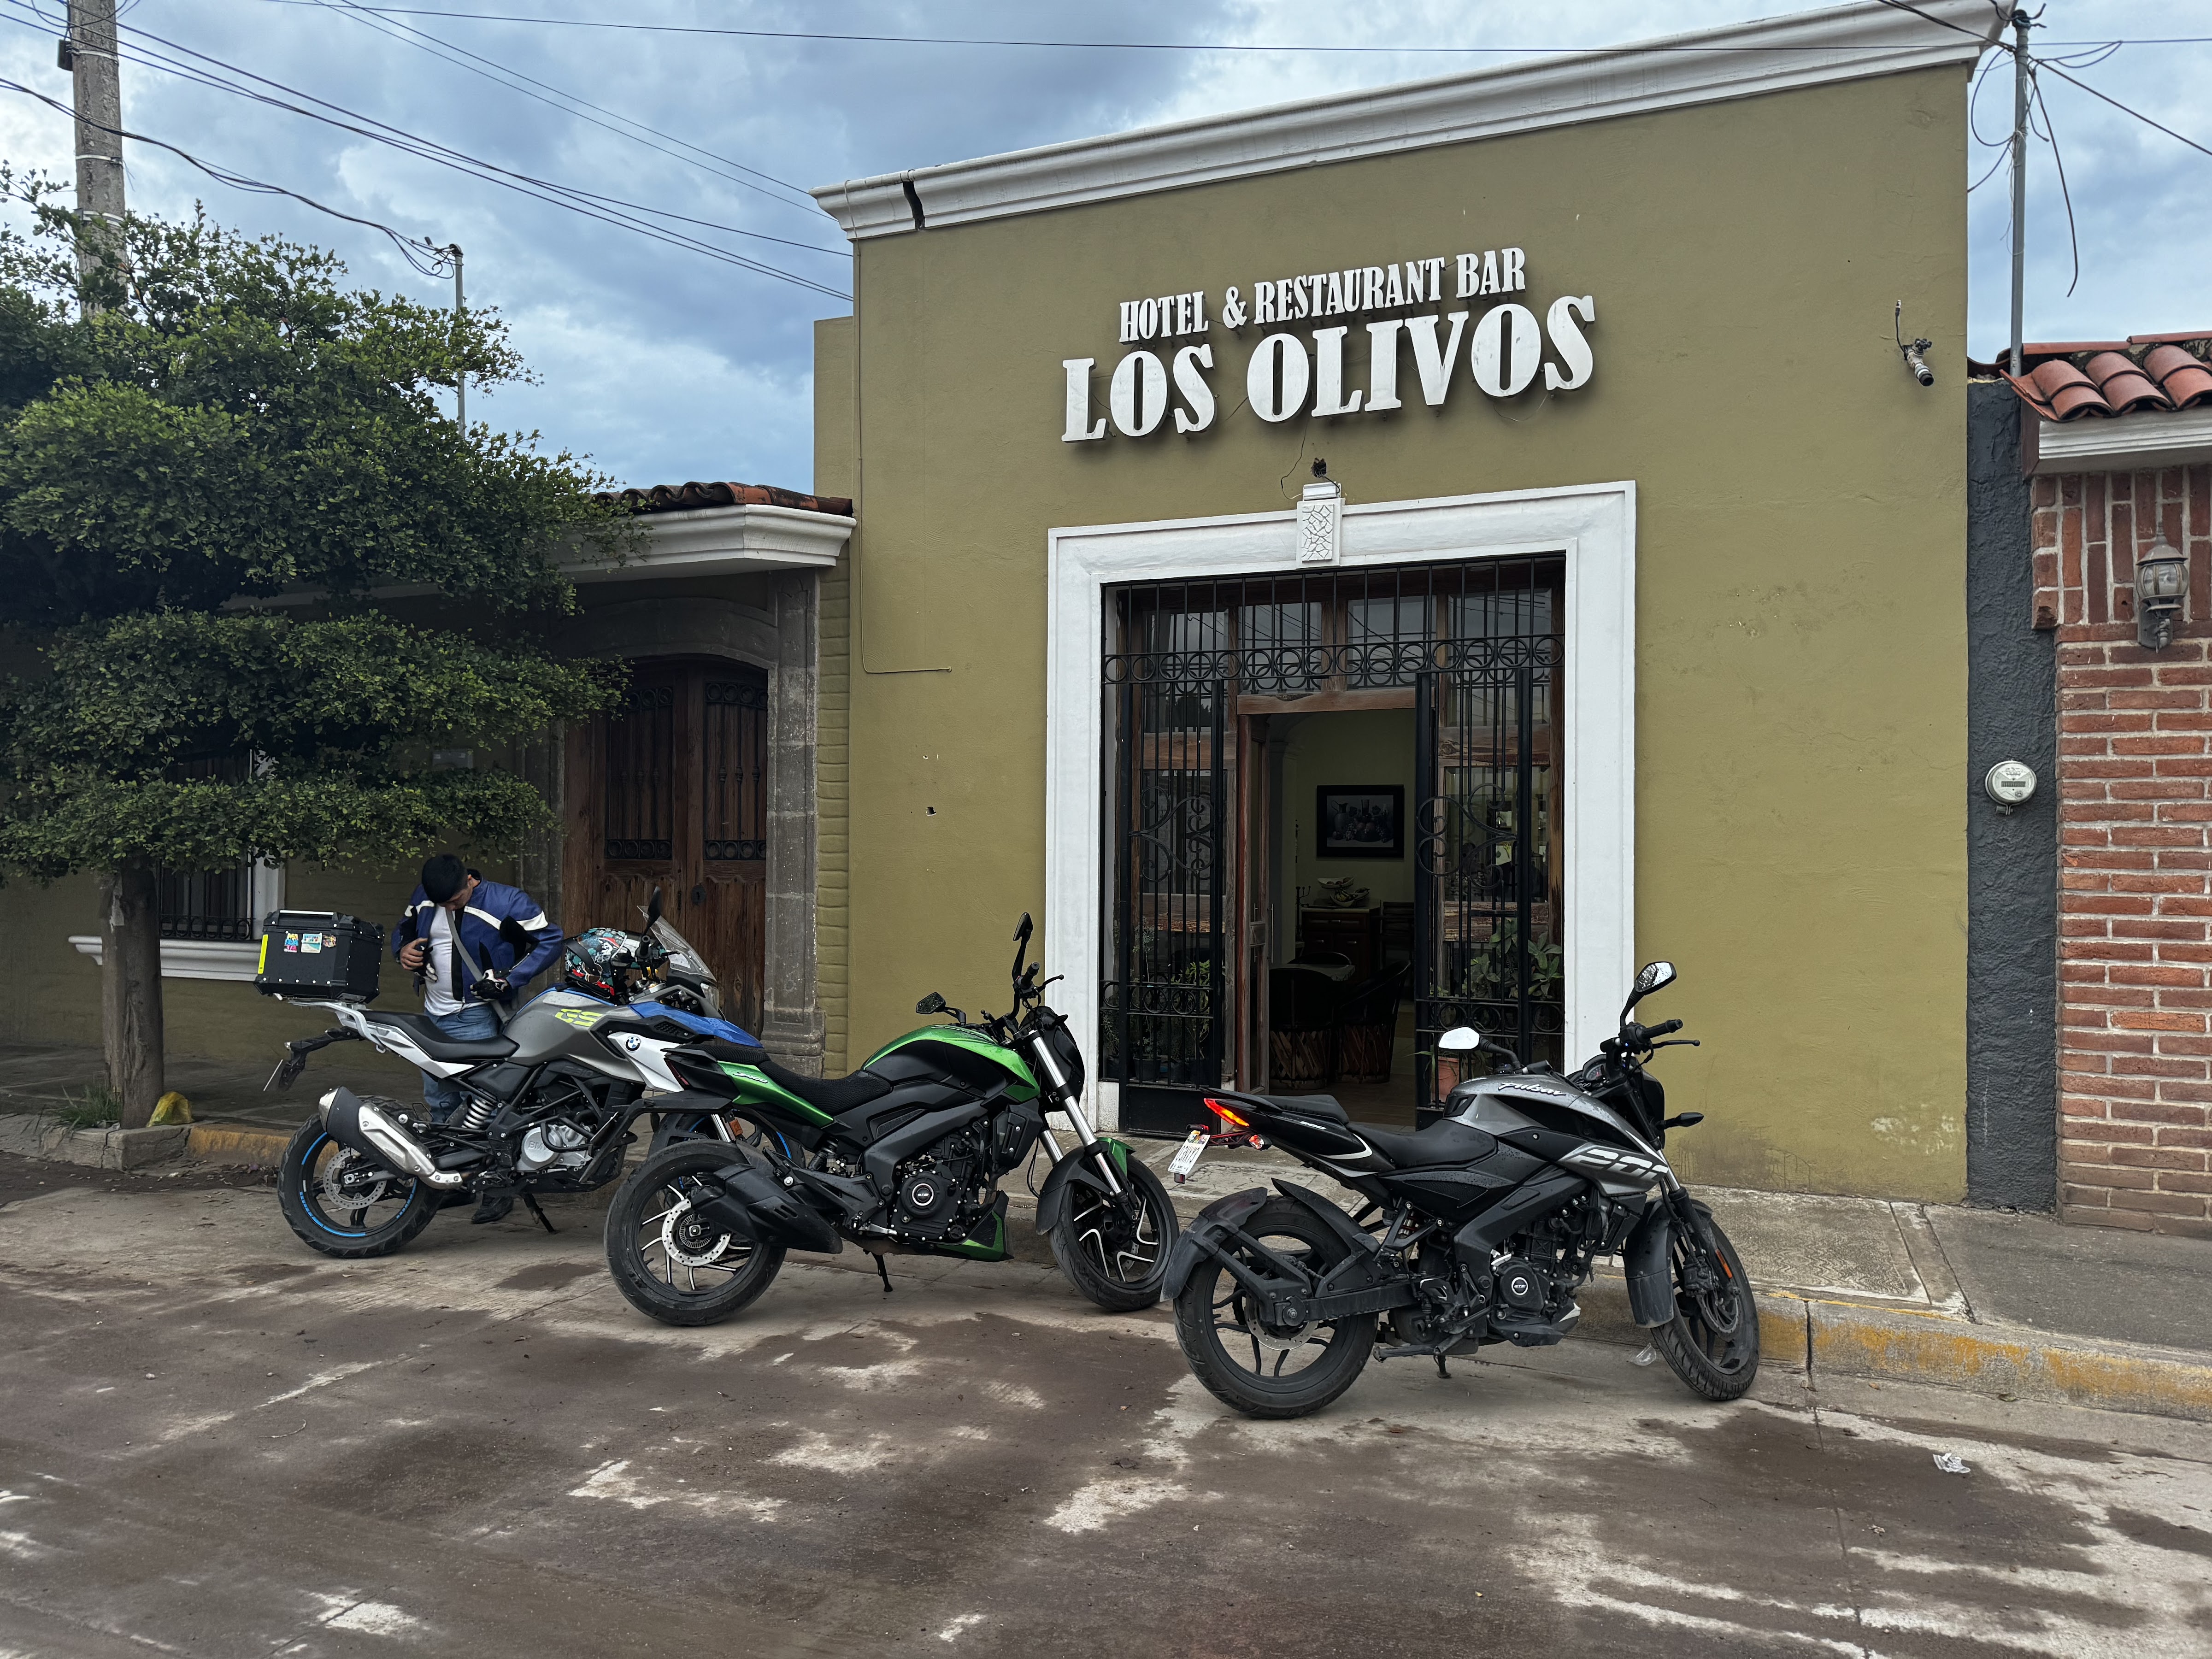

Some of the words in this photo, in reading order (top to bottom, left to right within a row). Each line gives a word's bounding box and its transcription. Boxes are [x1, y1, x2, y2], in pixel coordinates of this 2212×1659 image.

[1119, 291, 1209, 343] HOTEL
[1223, 286, 1247, 329] &
[1254, 257, 1445, 325] RESTAURANT
[1456, 247, 1525, 298] BAR
[1061, 344, 1215, 442] LOS
[1247, 295, 1595, 423] OLIVOS
[555, 1008, 603, 1027] GS
